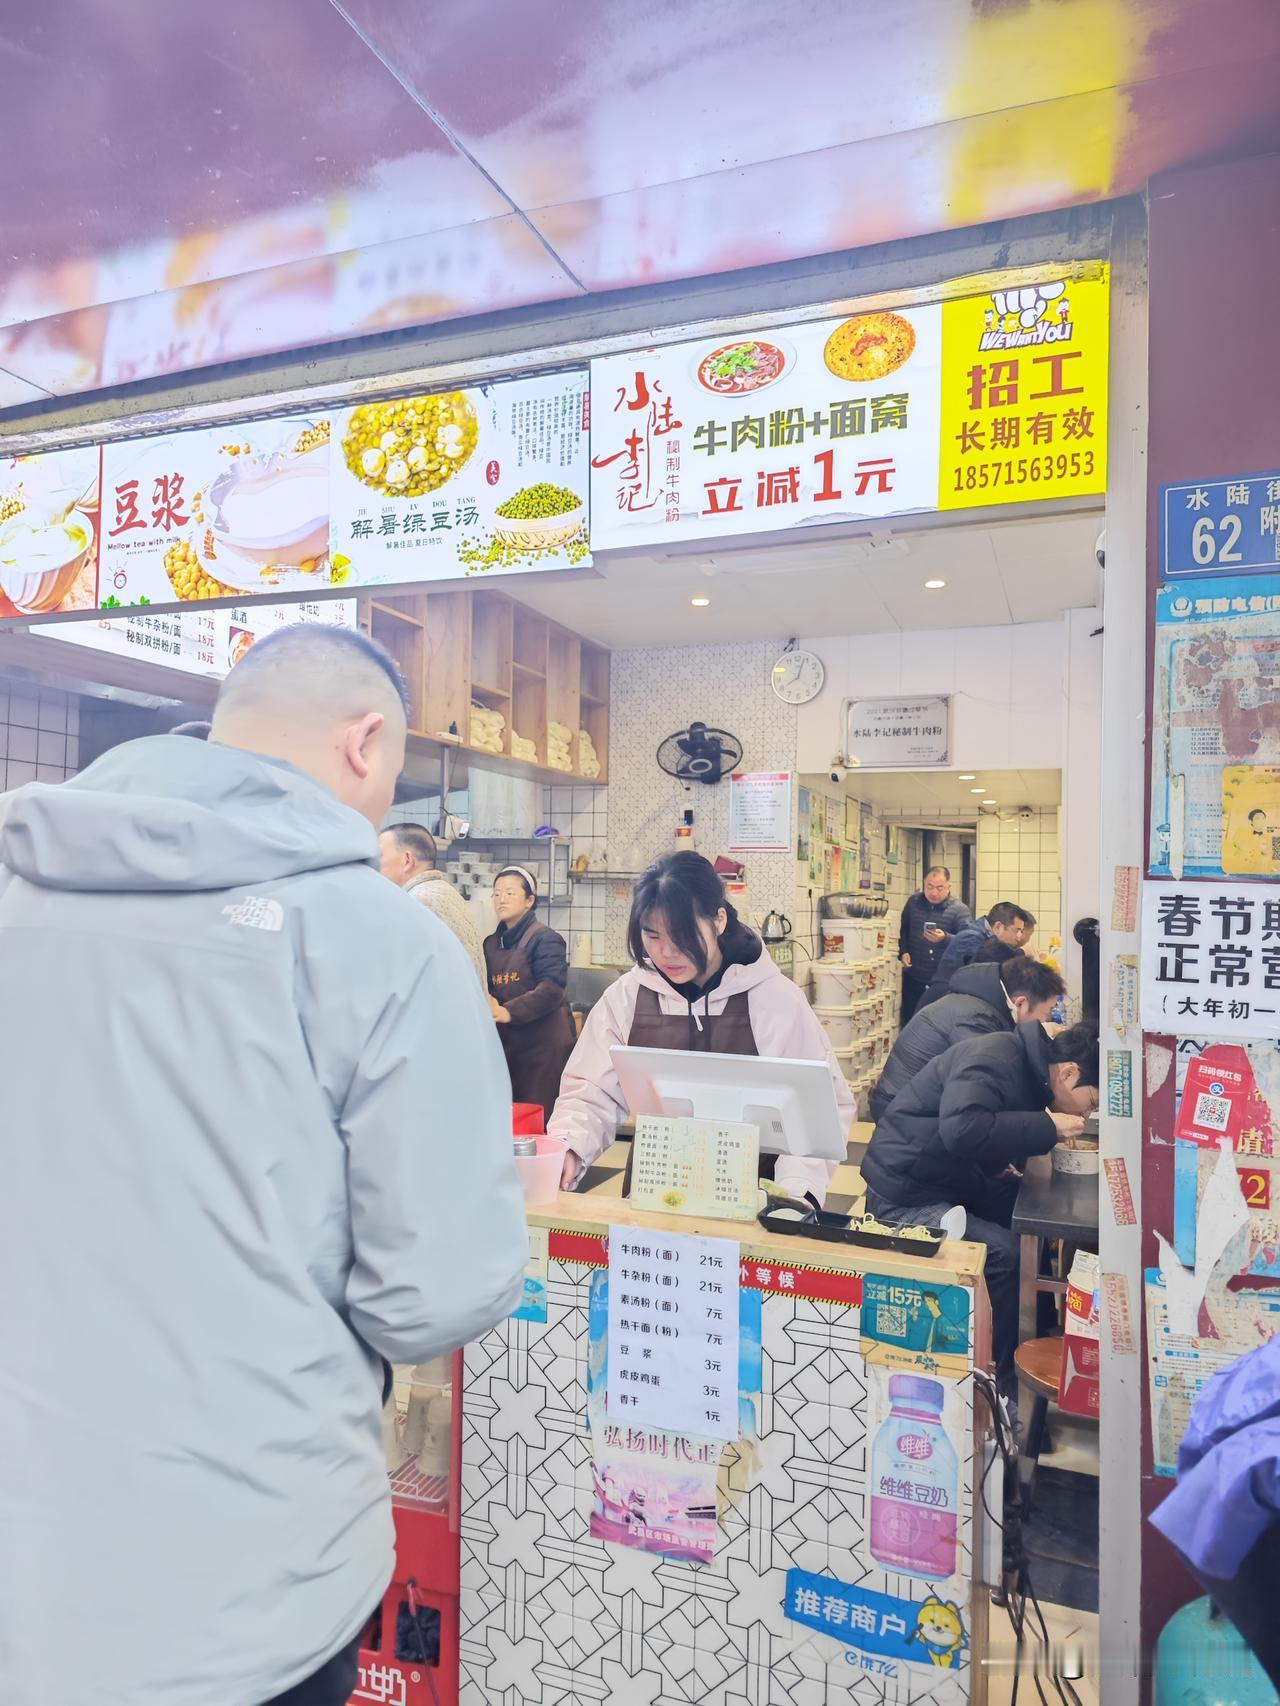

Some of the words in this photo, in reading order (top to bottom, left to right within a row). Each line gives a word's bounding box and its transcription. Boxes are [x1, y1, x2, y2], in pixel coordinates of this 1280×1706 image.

[967, 352, 1084, 410] 招工
[693, 392, 909, 456] 牛肉粉+面窝
[955, 406, 1095, 455] 长期有效
[666, 440, 680, 522] 秘制牛肉粉
[702, 449, 896, 515] 立减1元
[954, 451, 1095, 491] 18571563953
[108, 472, 190, 537] 豆浆
[432, 500, 447, 508] DOU
[350, 506, 480, 539] 解暑绿豆汤
[107, 542, 130, 551] Mellow
[1192, 514, 1242, 565] 62
[853, 726, 942, 738] 水陆李记秘制牛肉粉
[621, 1244, 679, 1262] 牛肉粉（面）
[699, 1255, 723, 1268] 21元
[621, 1269, 679, 1287] 牛杂粉（面）
[699, 1281, 723, 1294] 21元
[620, 1294, 679, 1313] 素汤粉（面）
[705, 1308, 722, 1320] 7元
[620, 1319, 679, 1338] 热干面（粉）
[705, 1333, 722, 1345] 7元
[620, 1345, 630, 1355] 豆
[642, 1349, 652, 1359] 浆
[704, 1360, 721, 1372] 3元
[620, 1370, 660, 1386] 虎皮鸡蛋
[702, 1386, 720, 1398] 3元
[620, 1394, 639, 1407] 香干
[705, 1411, 720, 1422] 1元
[880, 1476, 949, 1508] 维维豆奶
[794, 1587, 906, 1637] 推荐商户
[861, 1655, 898, 1679] 饿了么
